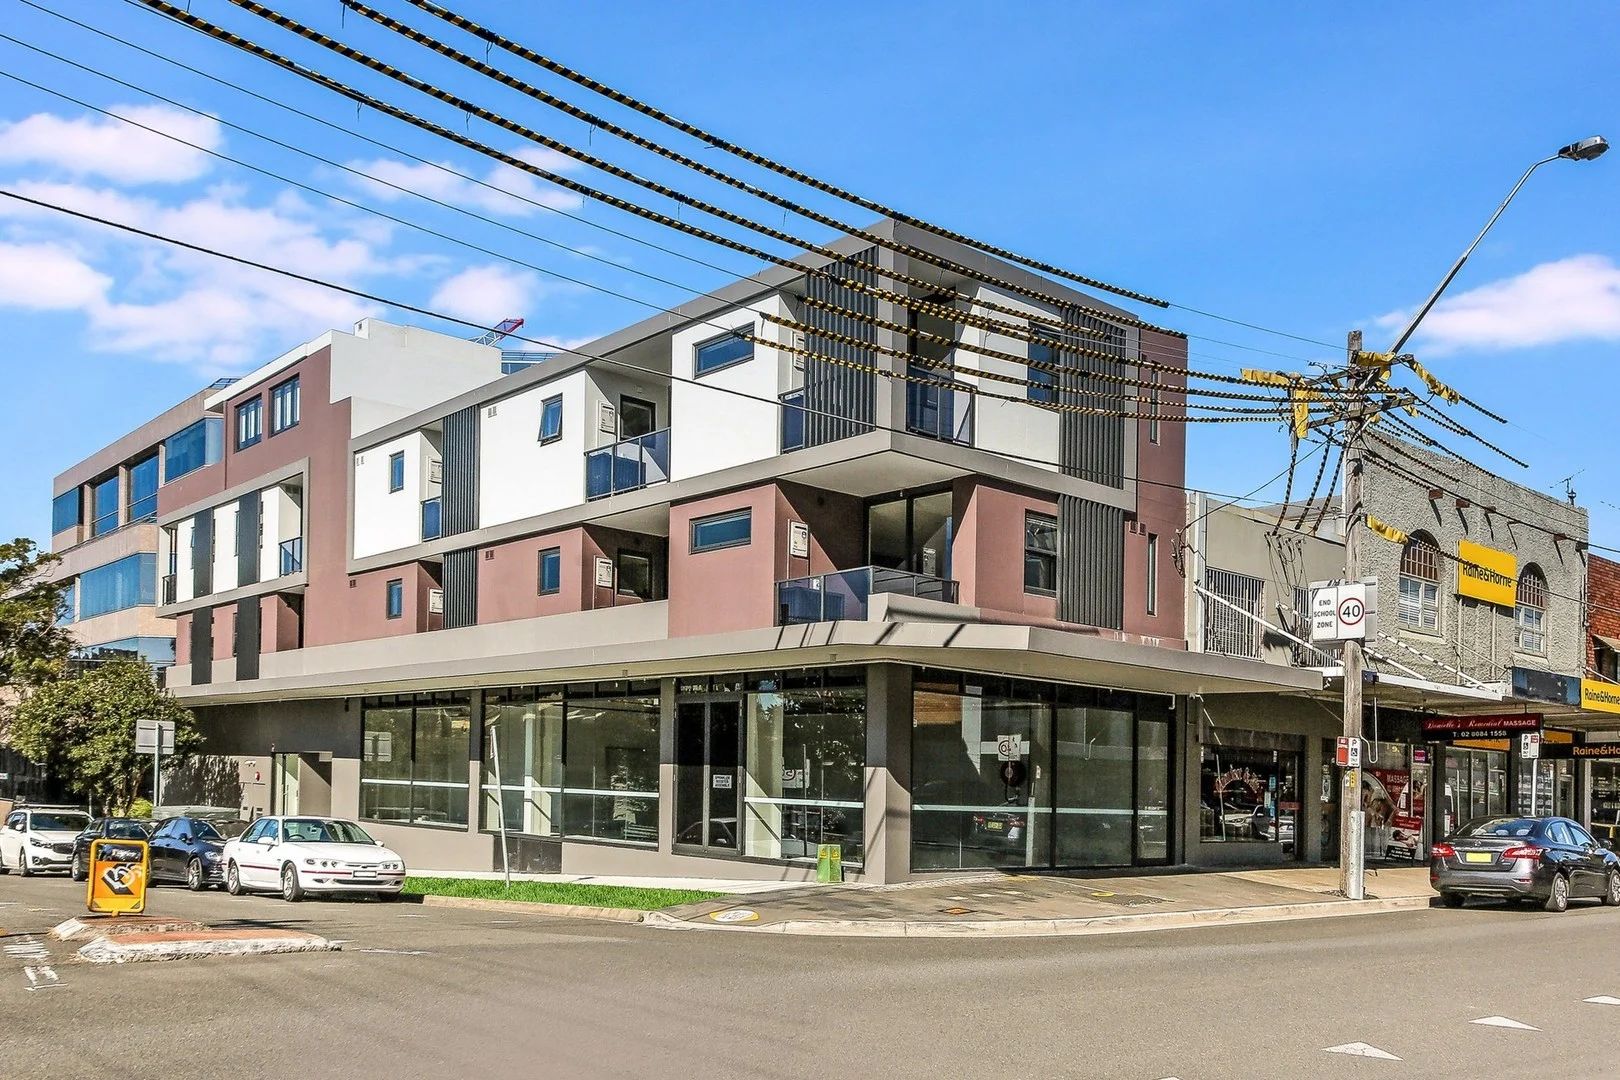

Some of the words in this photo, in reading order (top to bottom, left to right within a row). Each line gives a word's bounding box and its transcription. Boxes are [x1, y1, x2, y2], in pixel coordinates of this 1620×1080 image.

[1313, 610, 1336, 618] SCHOOL
[1342, 604, 1361, 618] 40
[1316, 621, 1333, 629] ZONE
